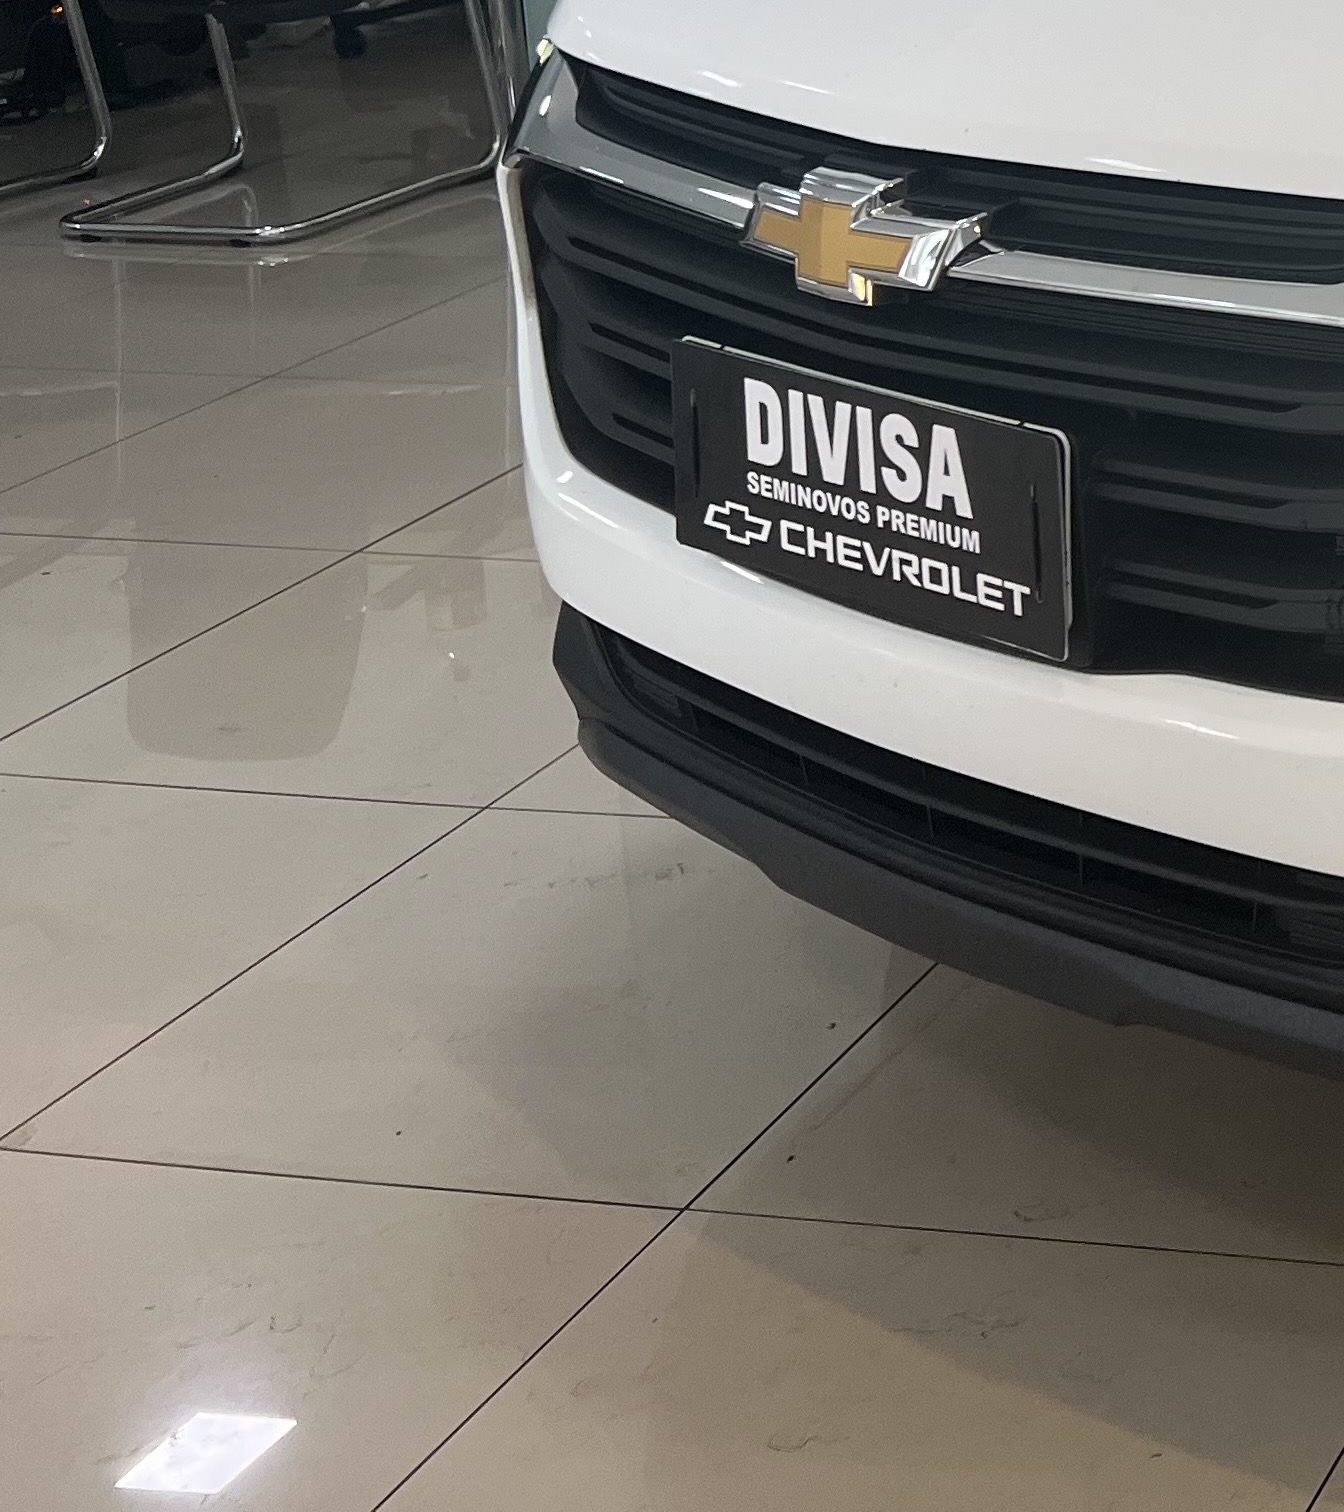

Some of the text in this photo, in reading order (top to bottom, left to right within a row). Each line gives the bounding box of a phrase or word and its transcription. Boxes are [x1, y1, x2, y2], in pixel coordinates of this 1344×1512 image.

[743, 377, 974, 520] DIVISA
[746, 470, 981, 555] SEMINOVOS PREMIUM
[779, 519, 1031, 617] CHEVROLET
